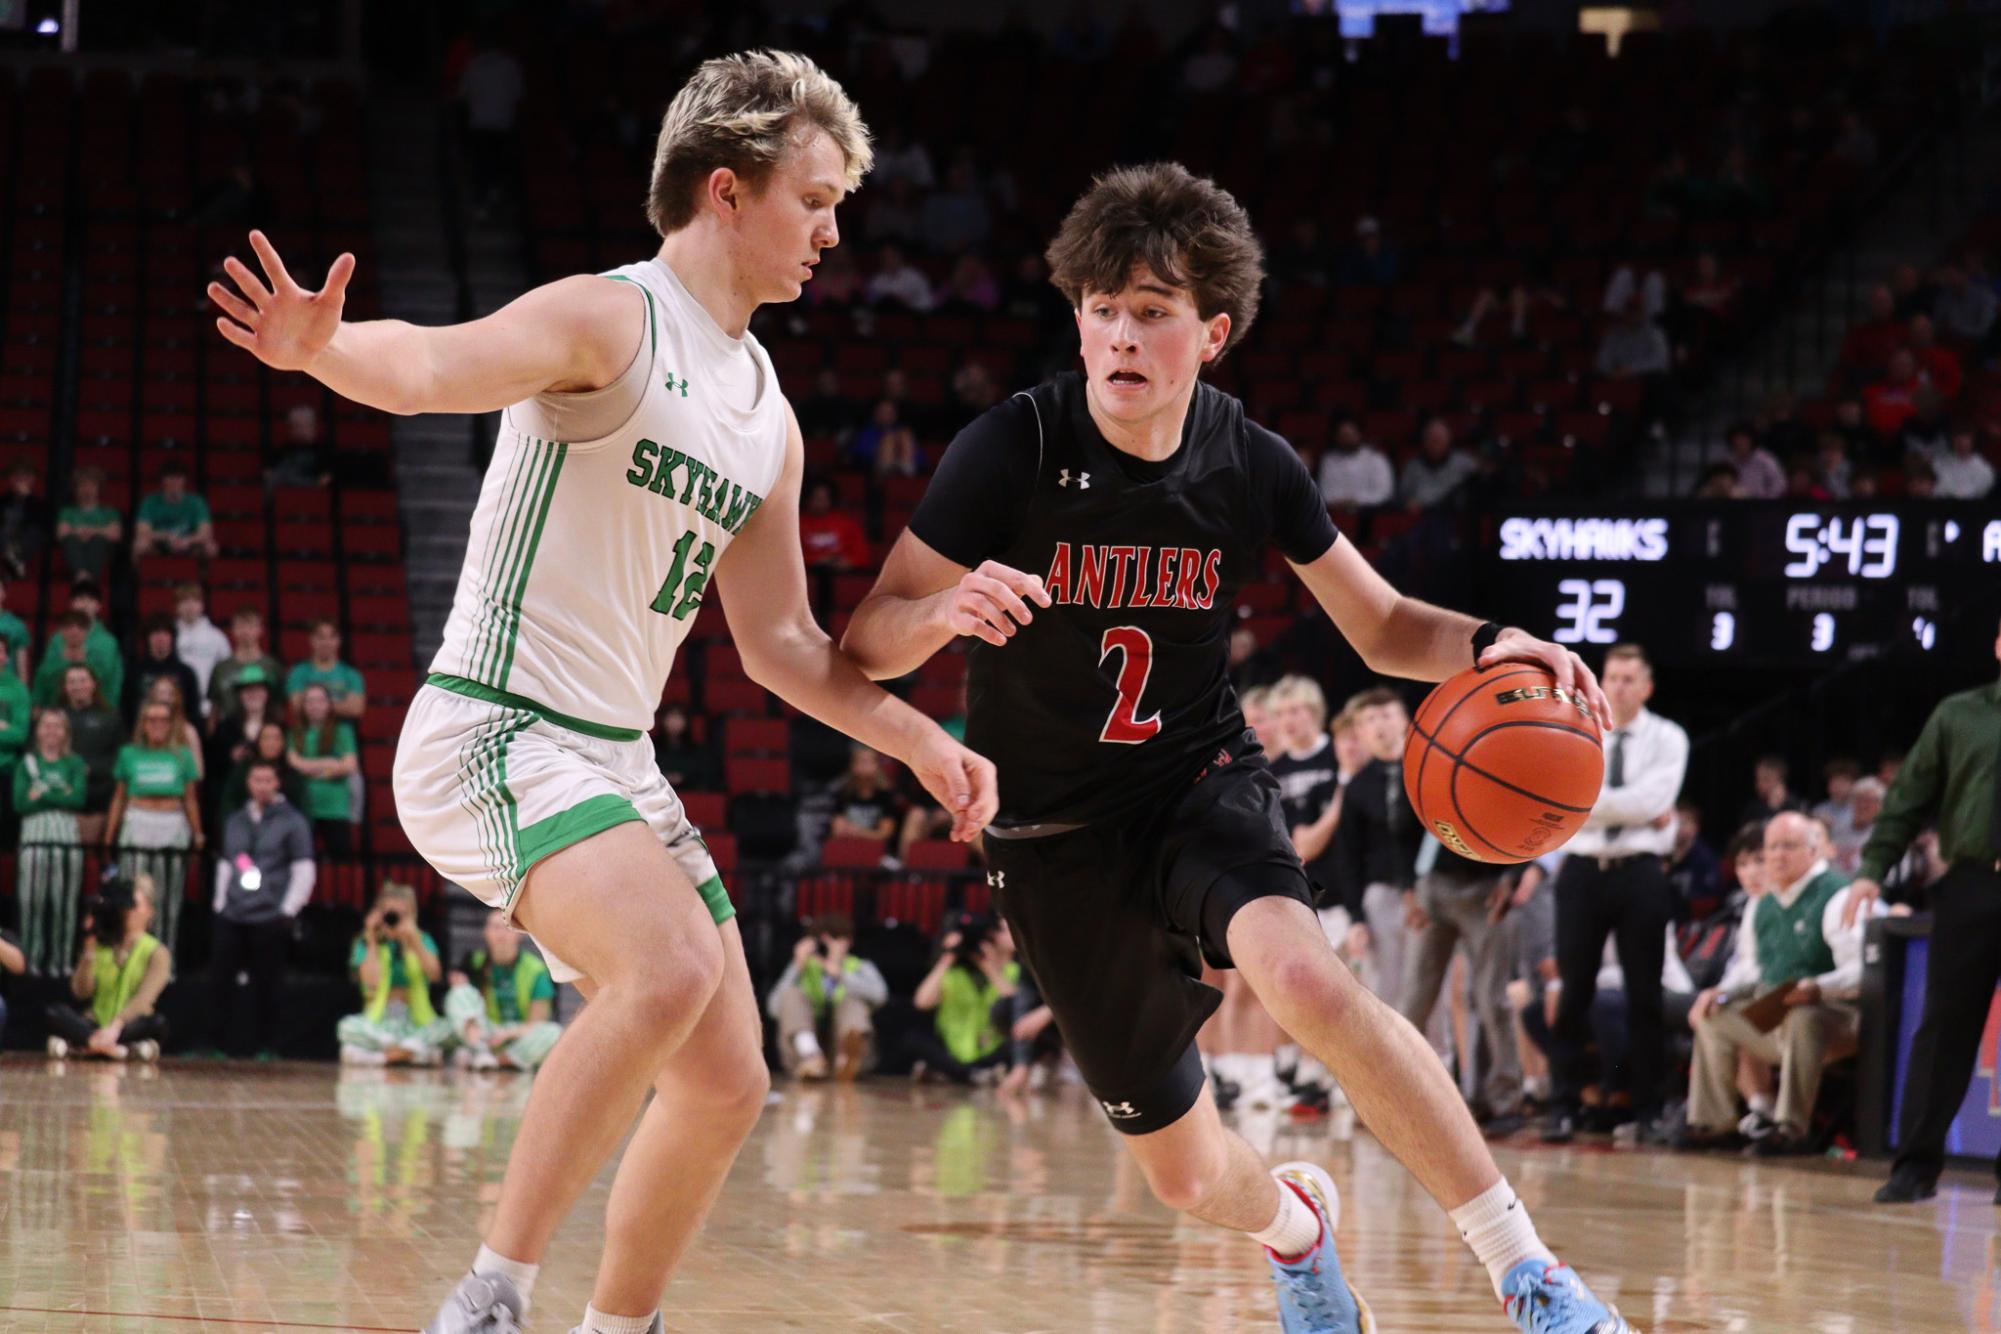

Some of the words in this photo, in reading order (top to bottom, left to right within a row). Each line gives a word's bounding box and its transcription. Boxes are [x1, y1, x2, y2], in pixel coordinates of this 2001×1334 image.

[1500, 517, 1669, 561] SKYHAWKS
[1785, 513, 1900, 578] 5:43
[649, 530, 715, 621] 12
[1045, 541, 1222, 610] ANTLERS
[1553, 579, 1626, 644] 32
[1098, 626, 1162, 744] 2
